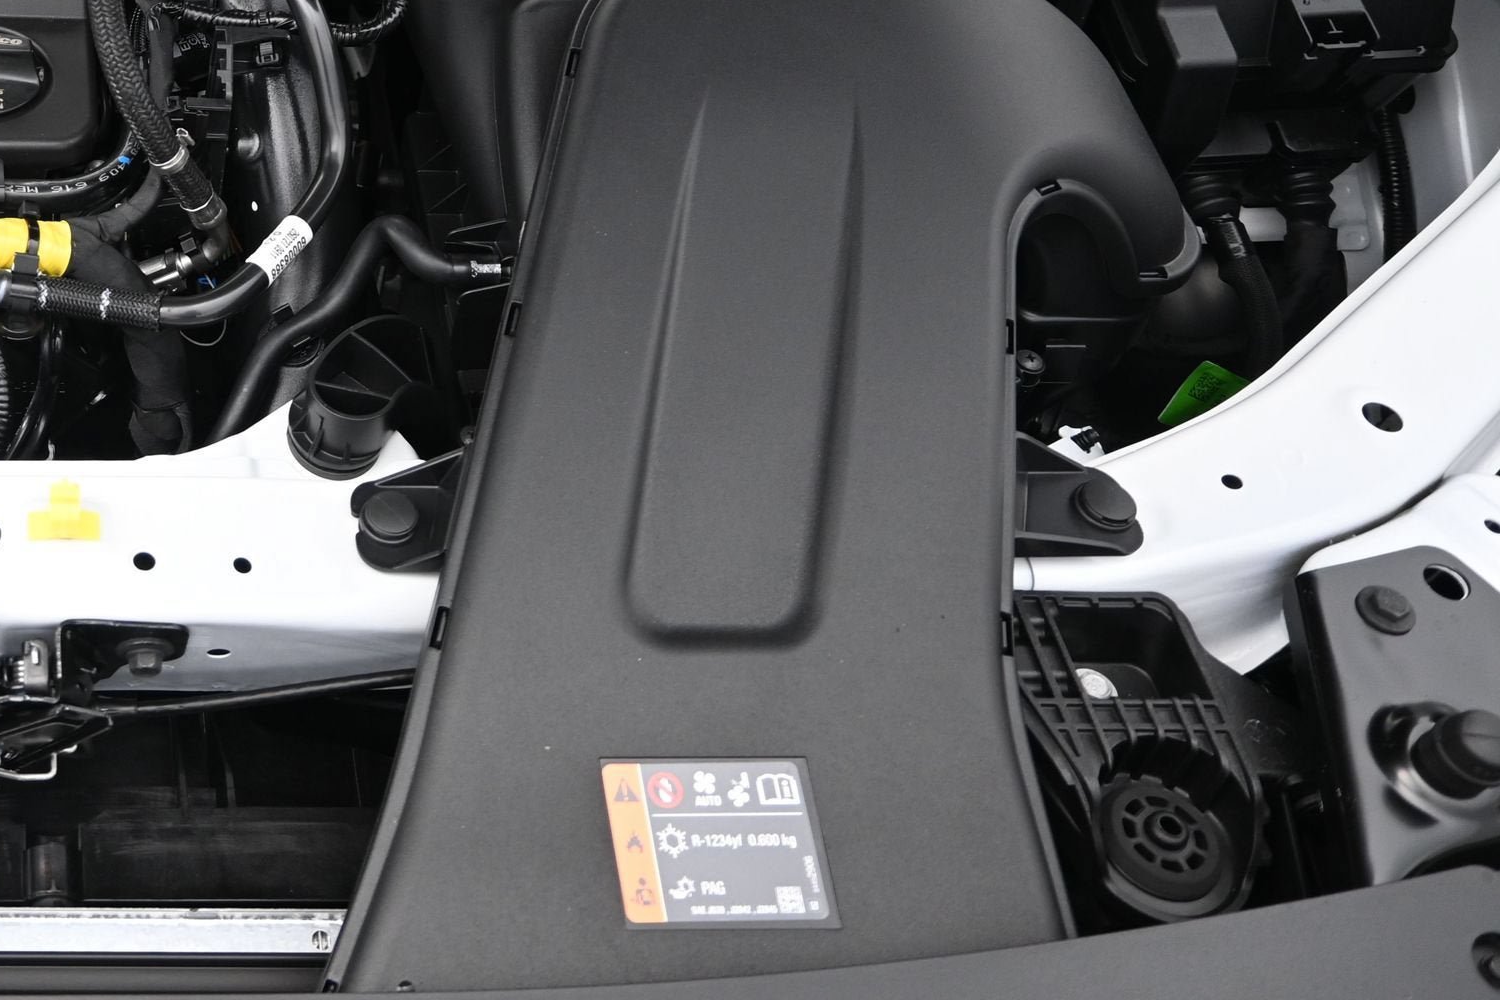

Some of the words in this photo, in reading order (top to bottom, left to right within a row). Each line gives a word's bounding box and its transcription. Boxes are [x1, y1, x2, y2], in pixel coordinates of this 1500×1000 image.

[694, 795, 723, 807] AUTO
[780, 833, 798, 849] kg
[700, 881, 726, 896] PAG
